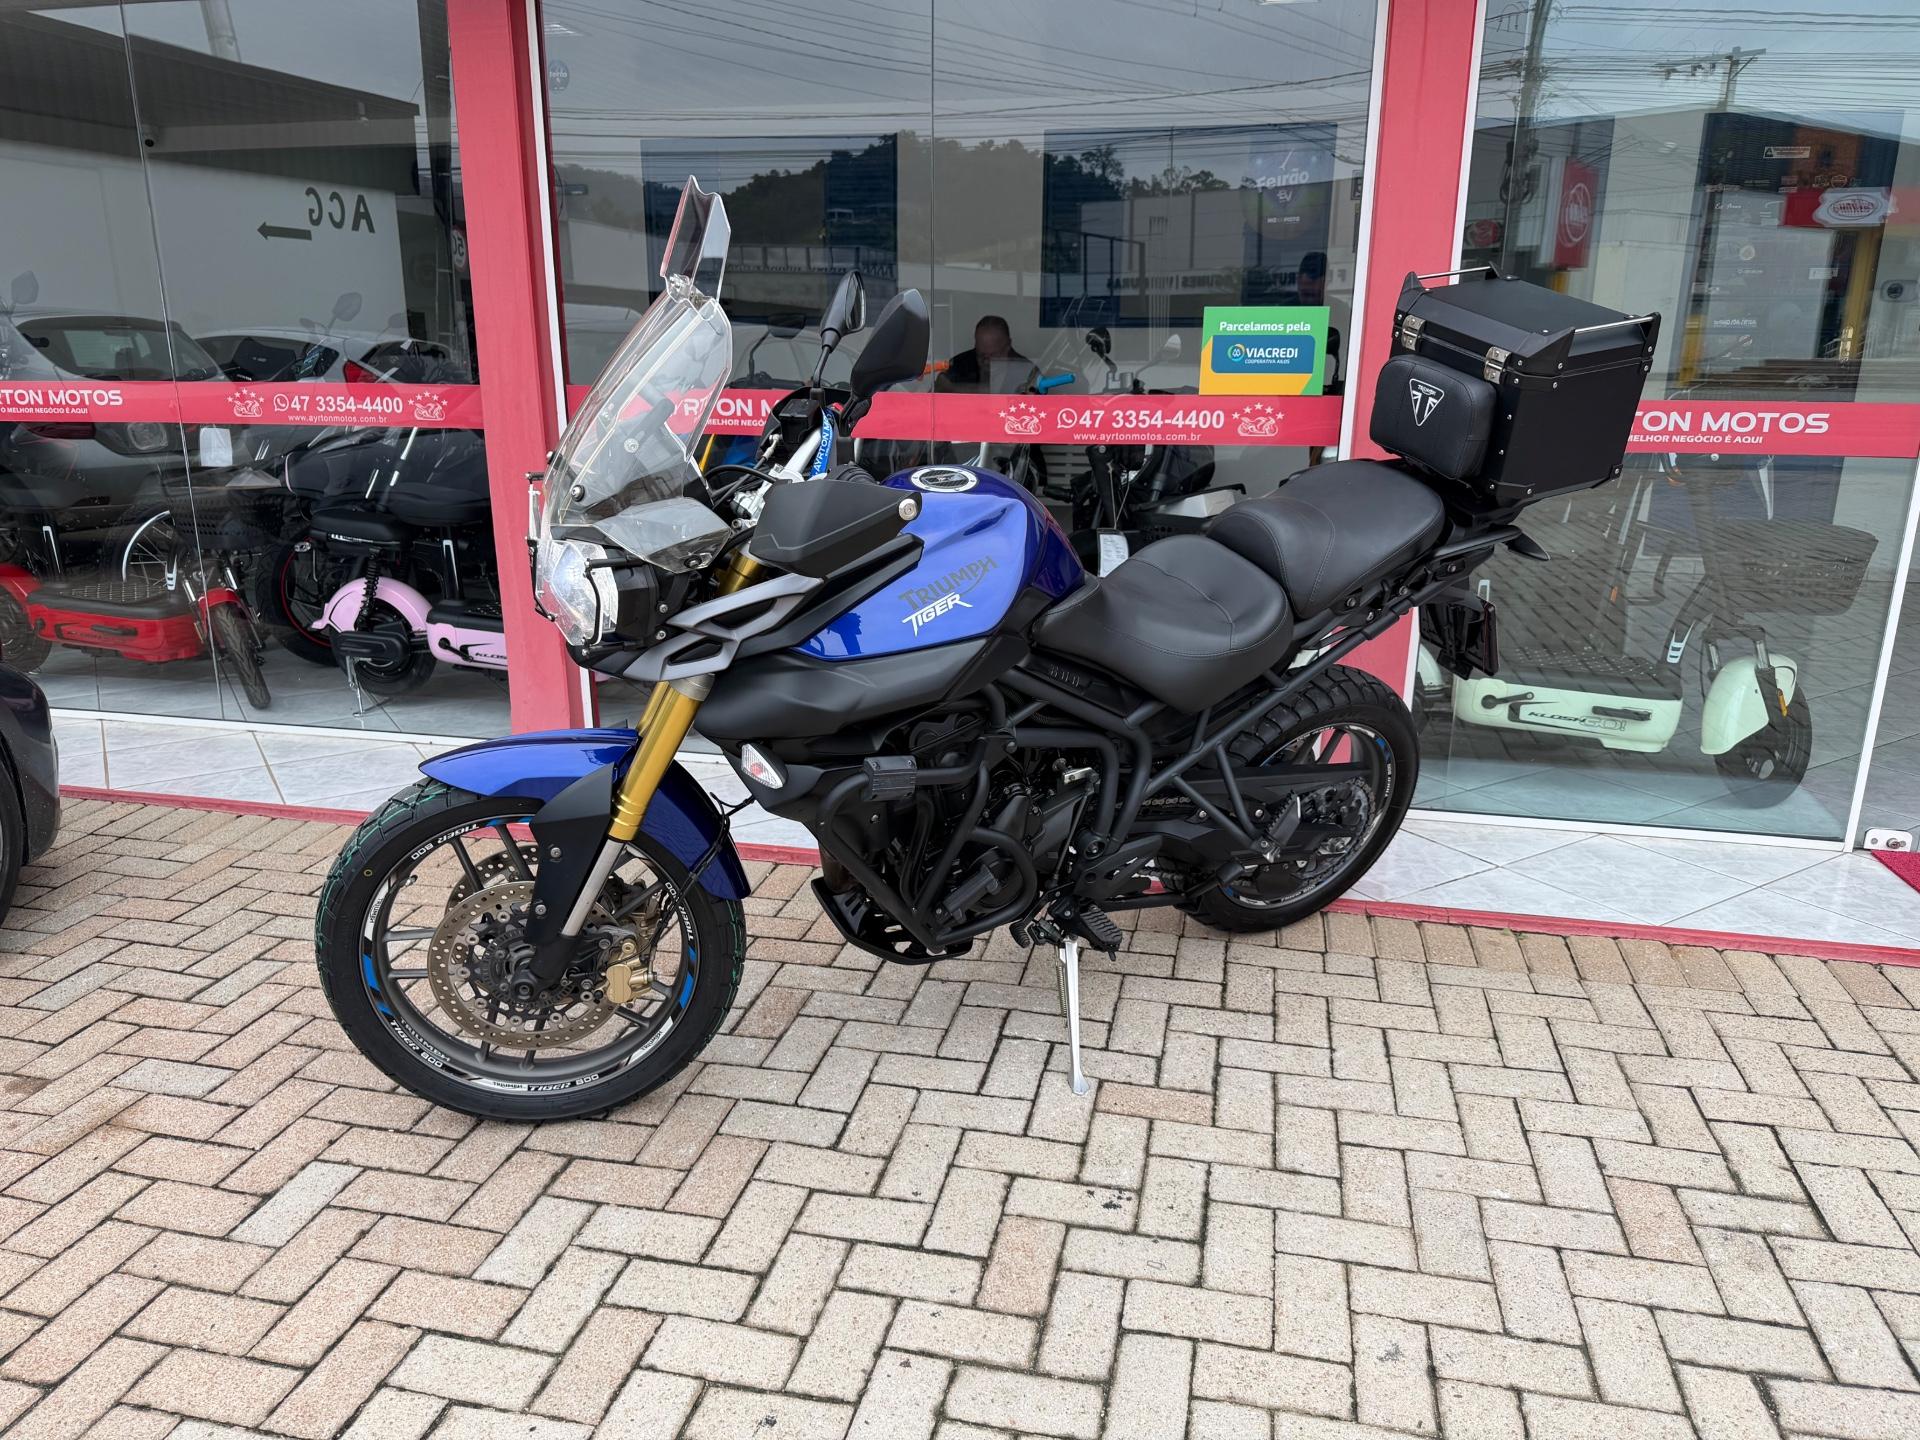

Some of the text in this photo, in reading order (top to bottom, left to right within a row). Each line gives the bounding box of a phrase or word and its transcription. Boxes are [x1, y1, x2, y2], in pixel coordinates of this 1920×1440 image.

[1219, 321, 1311, 333] Parcelamos pela
[1246, 347, 1298, 358] VIACREDI
[0, 389, 123, 406] TON MOTOS
[290, 395, 403, 413] 47 3354-4400
[35, 405, 64, 414] NEGÓCIO
[288, 414, 387, 424] www.ayrtonmotos.com.br
[1079, 410, 1225, 428] 47 3354-4400
[1701, 411, 1830, 433] MOTOS
[1073, 432, 1201, 441] www.ayrtonmotos.com.br
[1672, 433, 1722, 443] NEGÓCIO
[1724, 433, 1731, 443] É
[1734, 436, 1763, 444] AQUI
[898, 555, 999, 611] TRIUMPH
[902, 591, 973, 638] TIGER
[390, 1019, 443, 1068] TIGER 800
[528, 1082, 571, 1091] TIGER
[575, 1073, 599, 1086] 800
